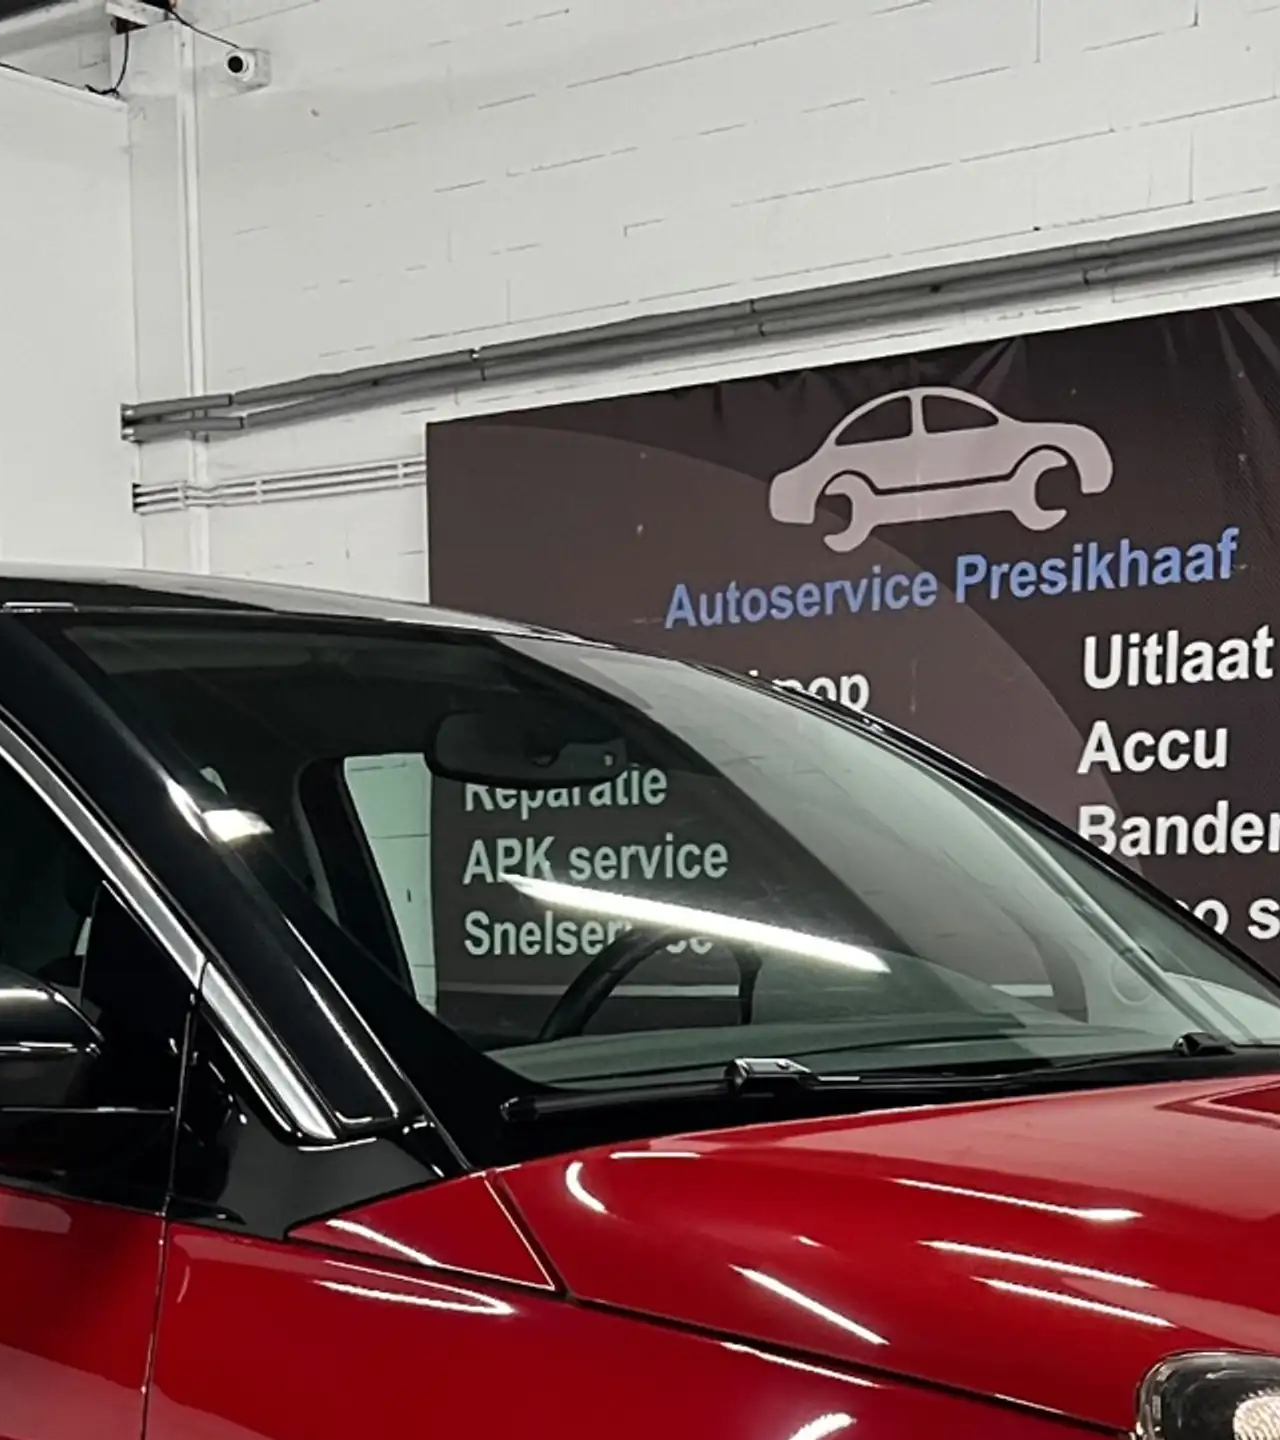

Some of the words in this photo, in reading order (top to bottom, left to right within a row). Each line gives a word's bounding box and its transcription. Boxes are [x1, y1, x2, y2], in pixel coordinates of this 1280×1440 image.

[664, 565, 938, 629] Autoservice
[955, 527, 1240, 603] Presikhaaf
[1082, 624, 1275, 690] Uitlaat
[1076, 719, 1228, 774] Accu
[462, 836, 556, 885] APK
[568, 832, 729, 882] service
